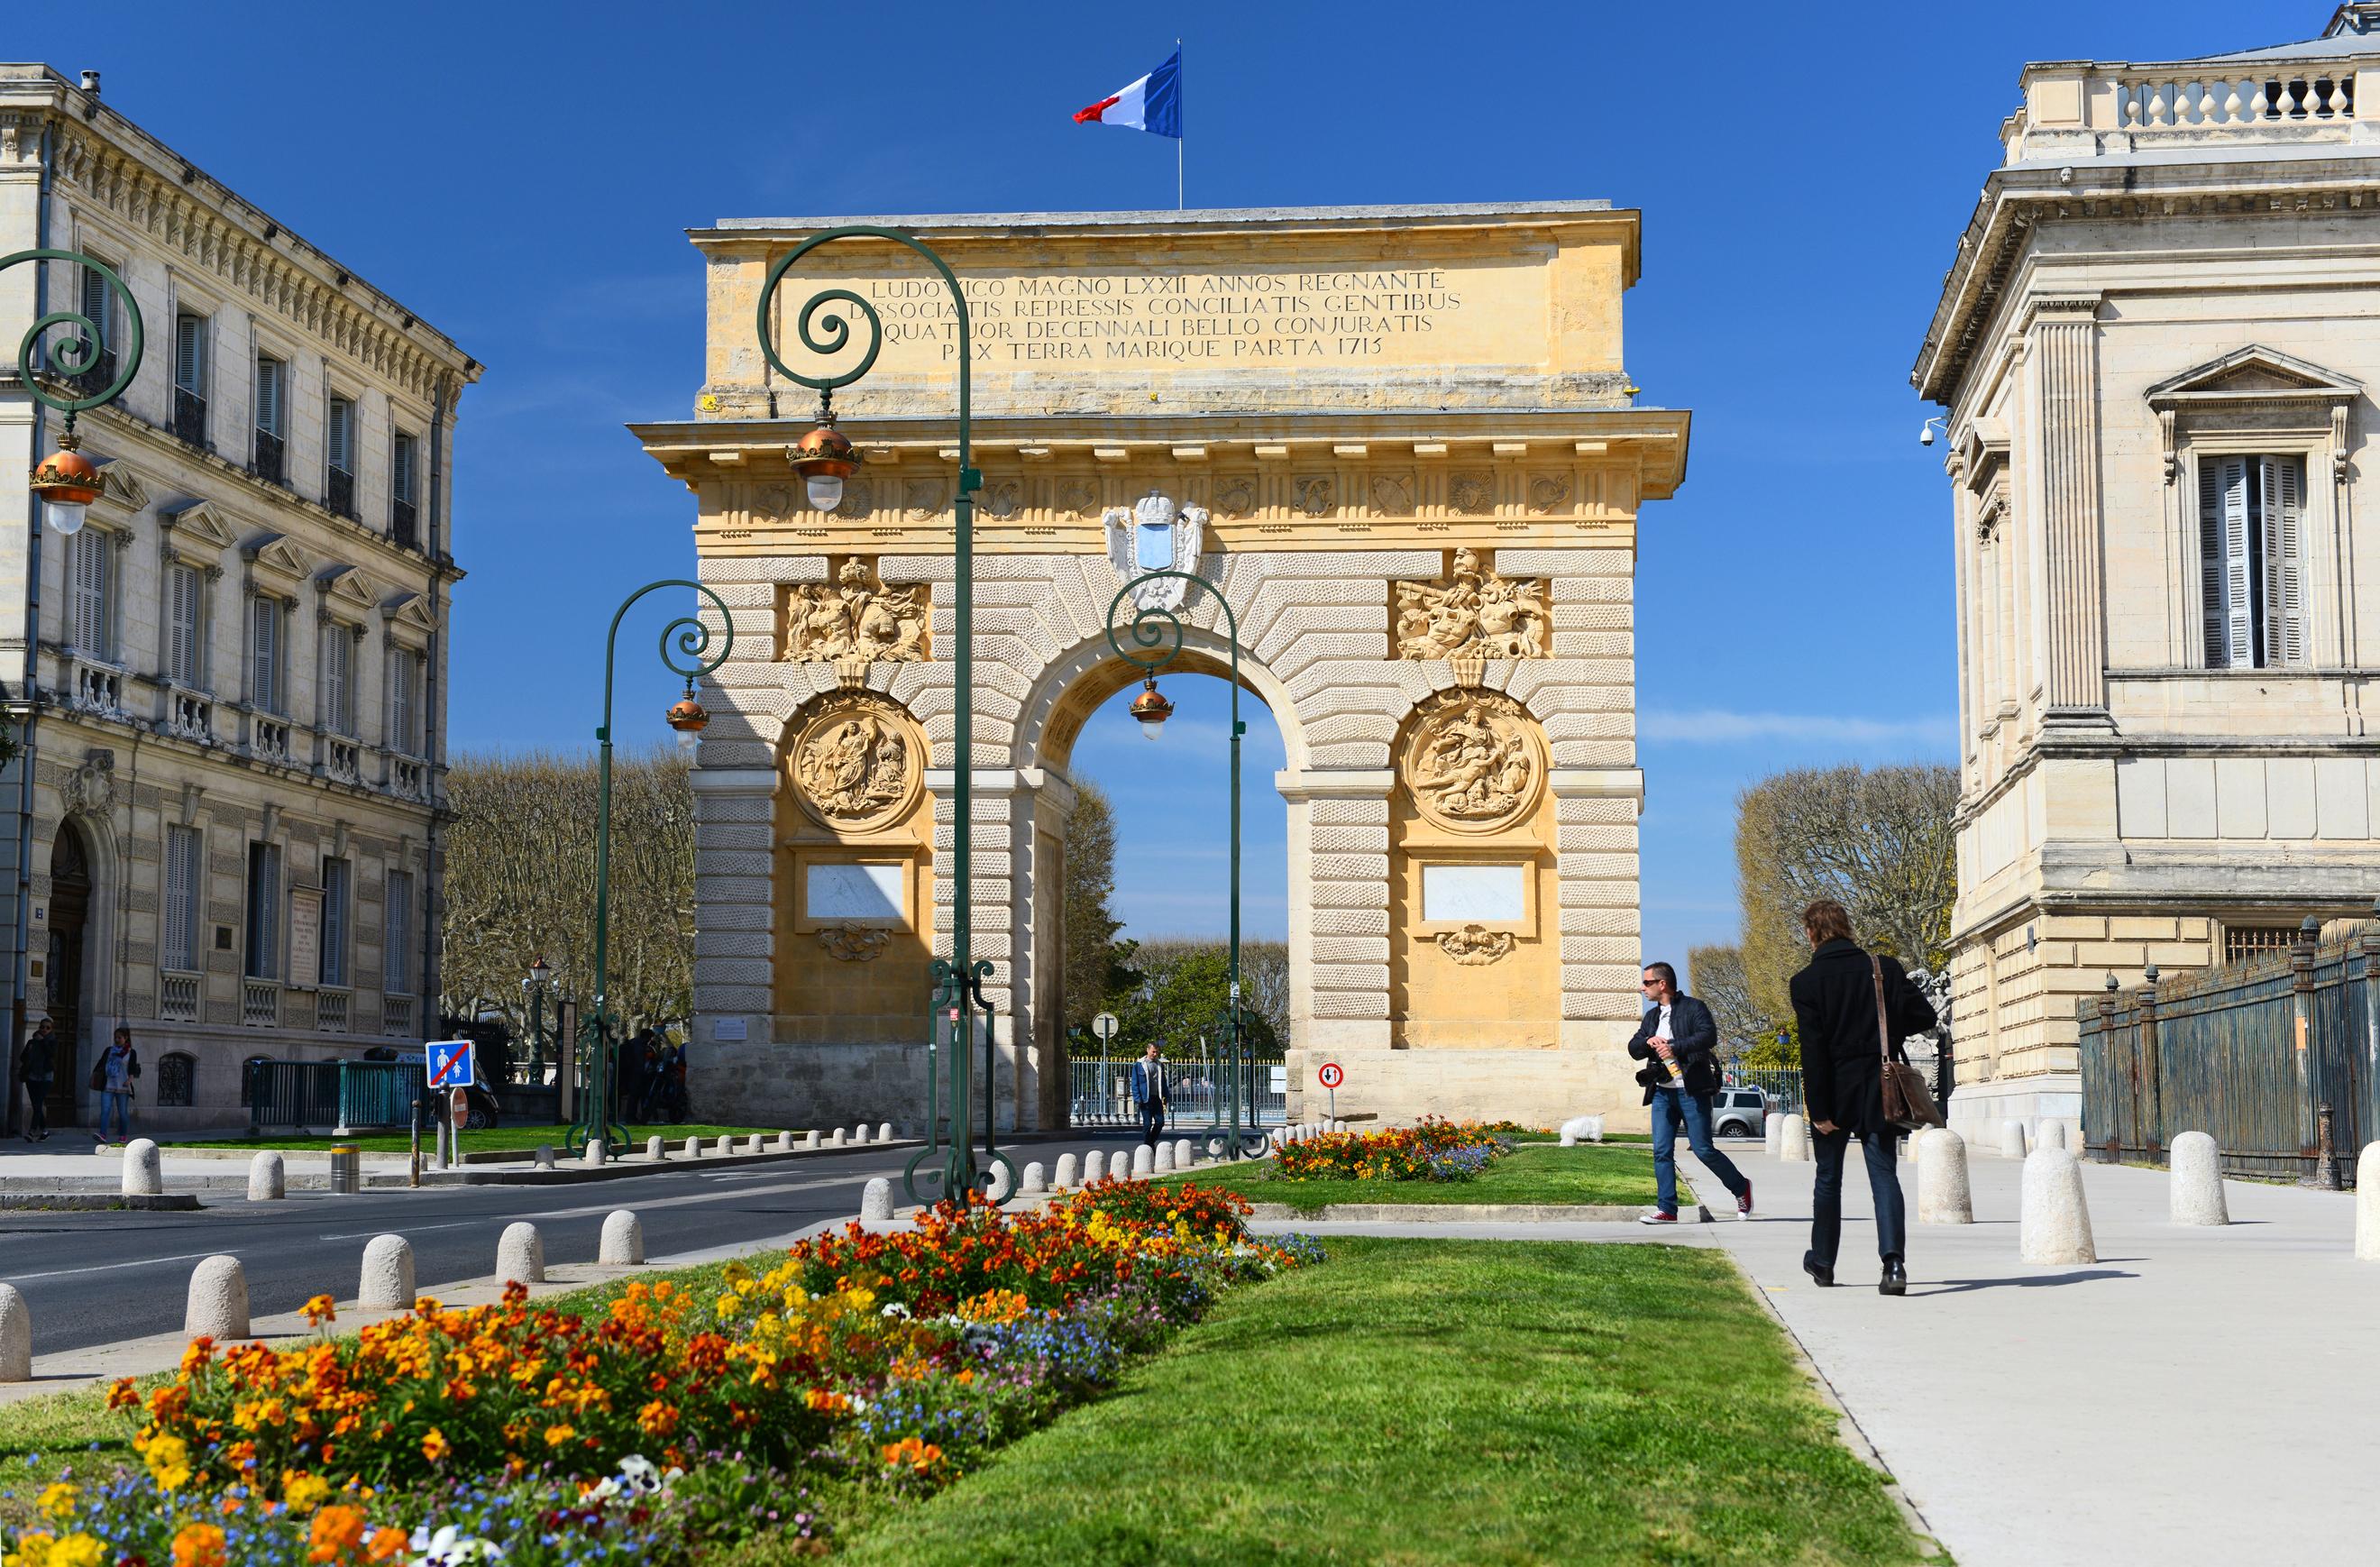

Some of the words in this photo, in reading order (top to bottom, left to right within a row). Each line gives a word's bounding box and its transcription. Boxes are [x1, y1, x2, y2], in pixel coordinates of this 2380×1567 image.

[872, 279, 1005, 298] LUDOVICO
[1019, 278, 1111, 297] MAGNO
[1124, 277, 1186, 295] LXXII
[1200, 275, 1286, 293] ANNOS
[1299, 271, 1445, 291] REGNANTE
[850, 301, 1002, 320] DSSOCIATIS
[1015, 298, 1134, 316] REPRESSIS
[1149, 296, 1311, 315] CONCILIATIS
[1324, 293, 1461, 312] GENTIBUS
[884, 322, 1013, 344] QUATUOR
[1027, 319, 1168, 338] DECENNALI
[1182, 317, 1260, 335] BELLO
[1274, 315, 1433, 335] CONJURATIS
[942, 344, 993, 361] PX
[1007, 342, 1092, 360] TERRA
[1106, 340, 1221, 362] MARIQUE
[1234, 338, 1323, 356] PARTA
[1339, 337, 1384, 354] 1715
